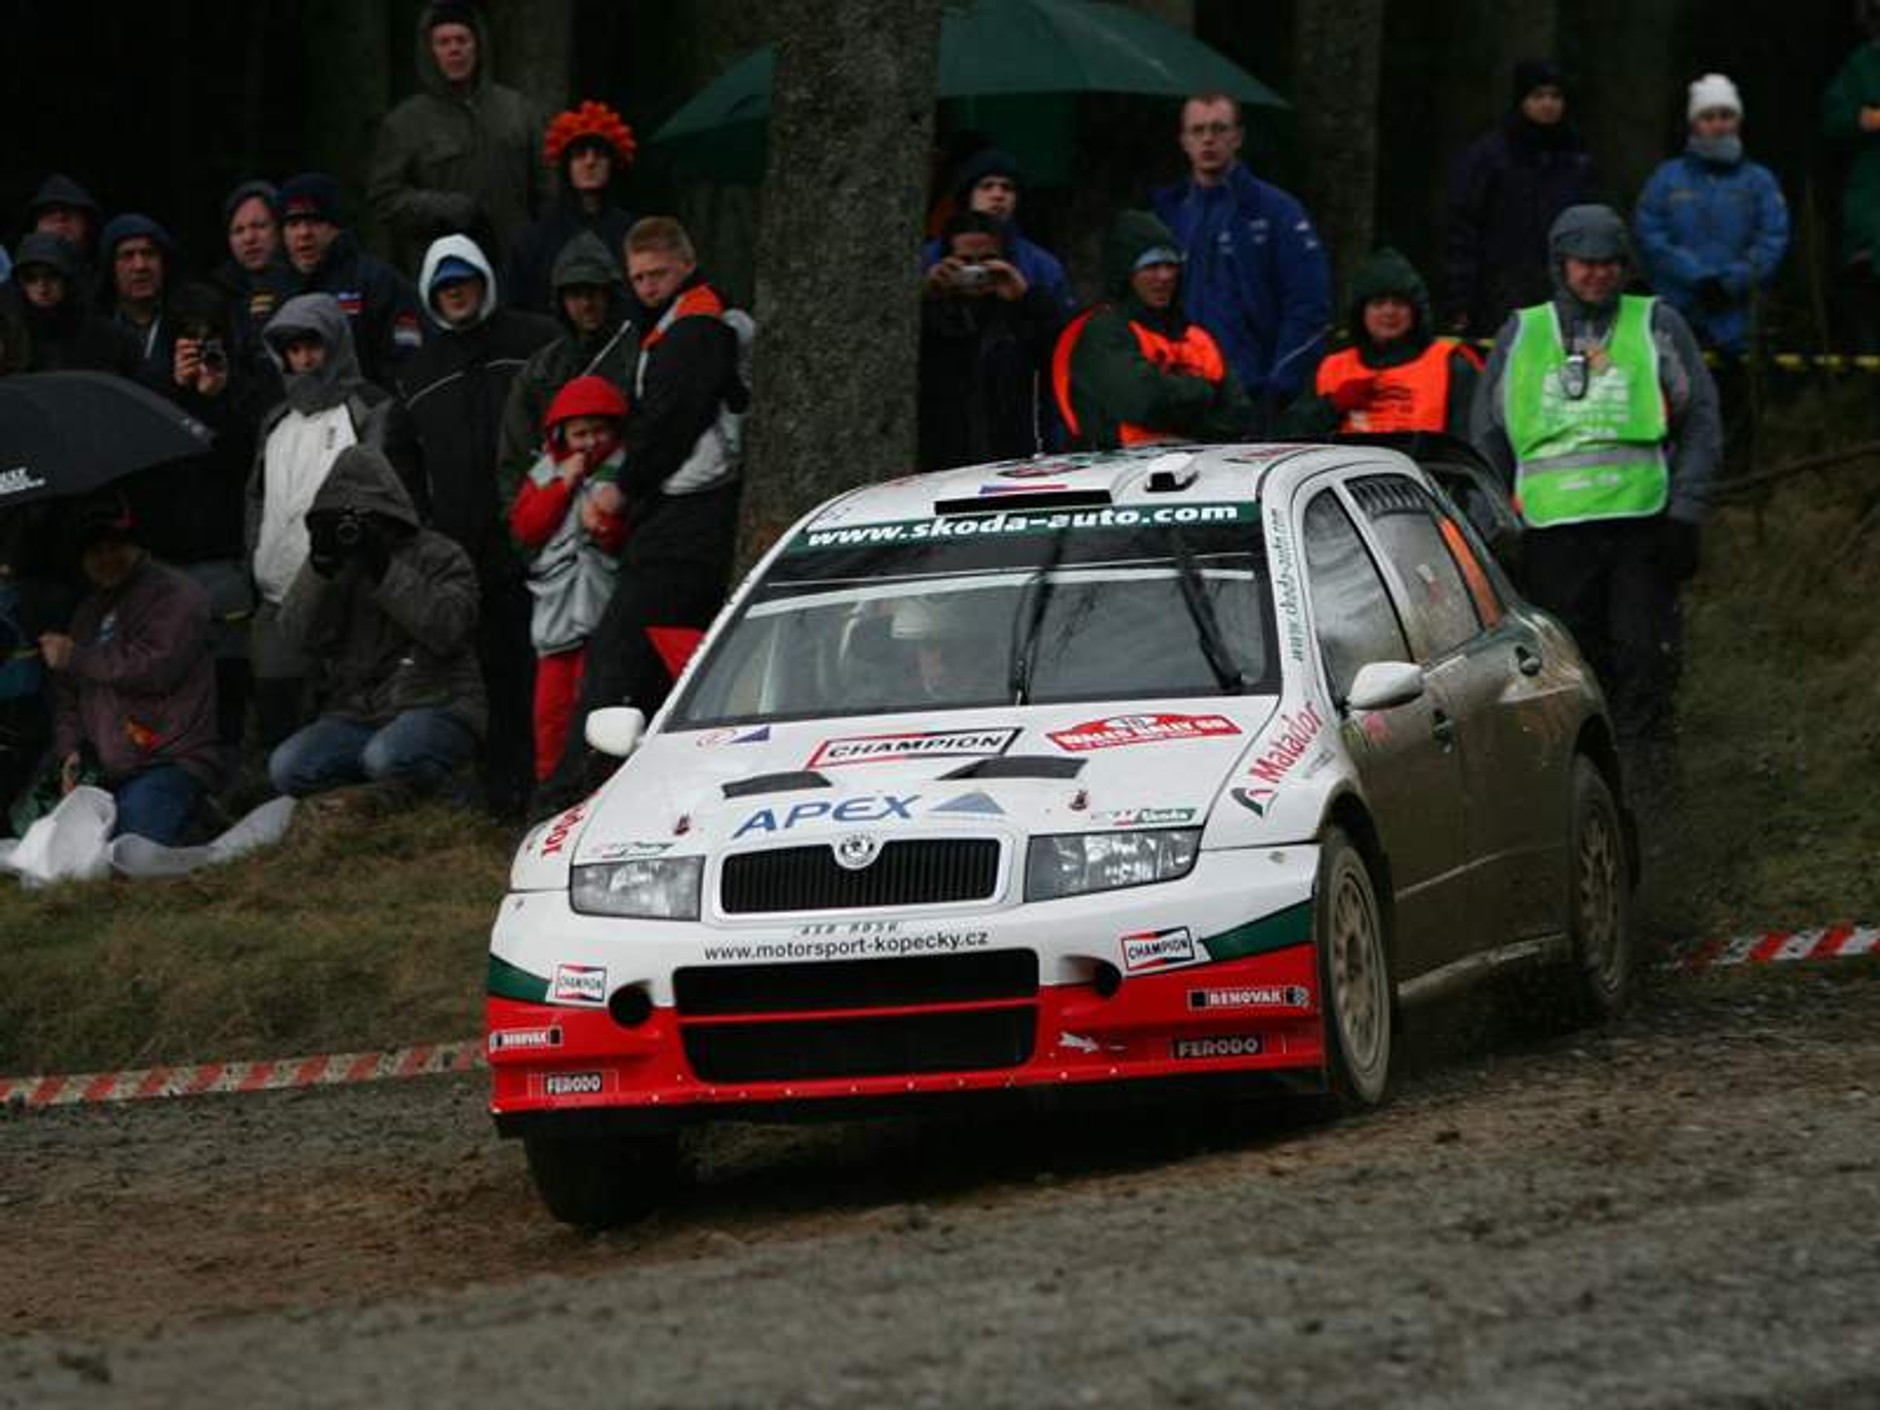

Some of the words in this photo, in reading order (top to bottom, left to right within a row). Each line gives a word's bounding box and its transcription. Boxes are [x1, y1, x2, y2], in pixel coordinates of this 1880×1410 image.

[808, 504, 1238, 546] www.skoda-auto.com
[827, 733, 1002, 759] CHAMPION
[1250, 701, 1322, 784] Matador
[731, 794, 922, 840] APEX
[704, 930, 989, 961] www.motorsport-kopecky.cz
[1128, 937, 1189, 960] CHAMPION
[1179, 1035, 1258, 1057] FERODO
